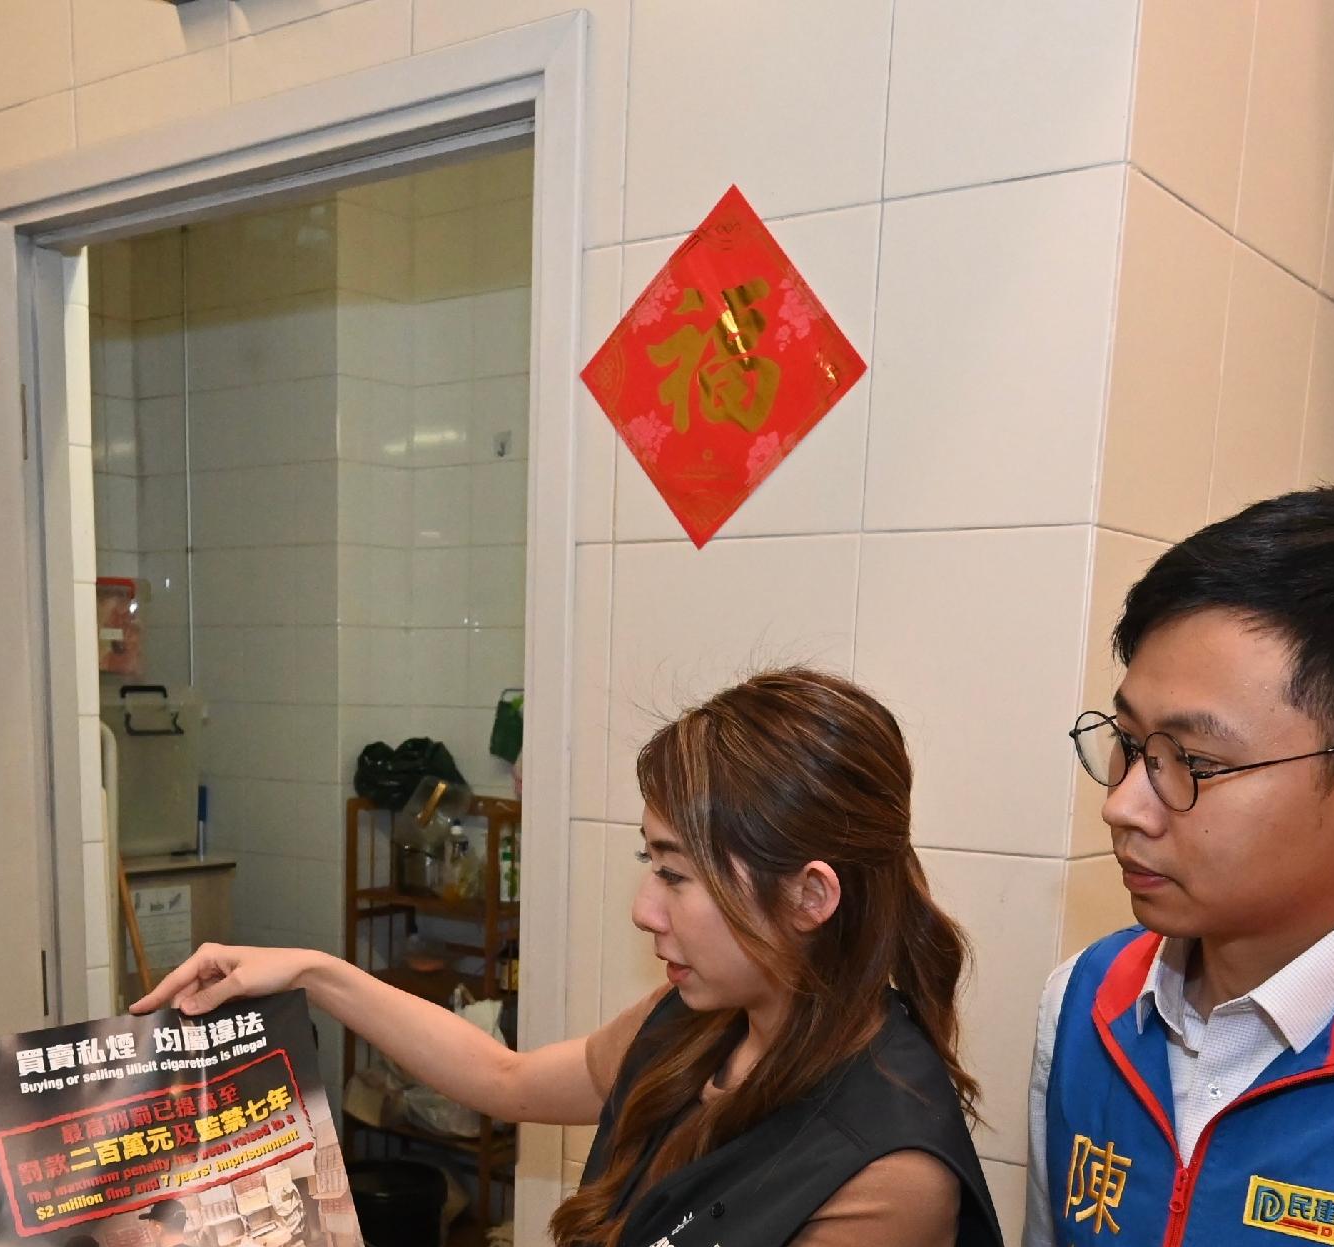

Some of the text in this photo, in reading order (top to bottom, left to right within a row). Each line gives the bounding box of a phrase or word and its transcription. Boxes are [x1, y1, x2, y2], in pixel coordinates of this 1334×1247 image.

[646, 276, 781, 434] 福
[16, 1011, 265, 1077] 買賣私煙 均屬違法
[20, 1037, 267, 1094] Buying or selling illicit cigarettes is illegal
[61, 1083, 240, 1144] 最高刑罰已提高至
[27, 1190, 51, 1204] The
[55, 1171, 120, 1195] maximum
[123, 1158, 171, 1180] penalty
[202, 1142, 231, 1160] been
[232, 1125, 271, 1148] raised
[35, 1129, 300, 1220] $2 million fine and 7 years' imprisonment
